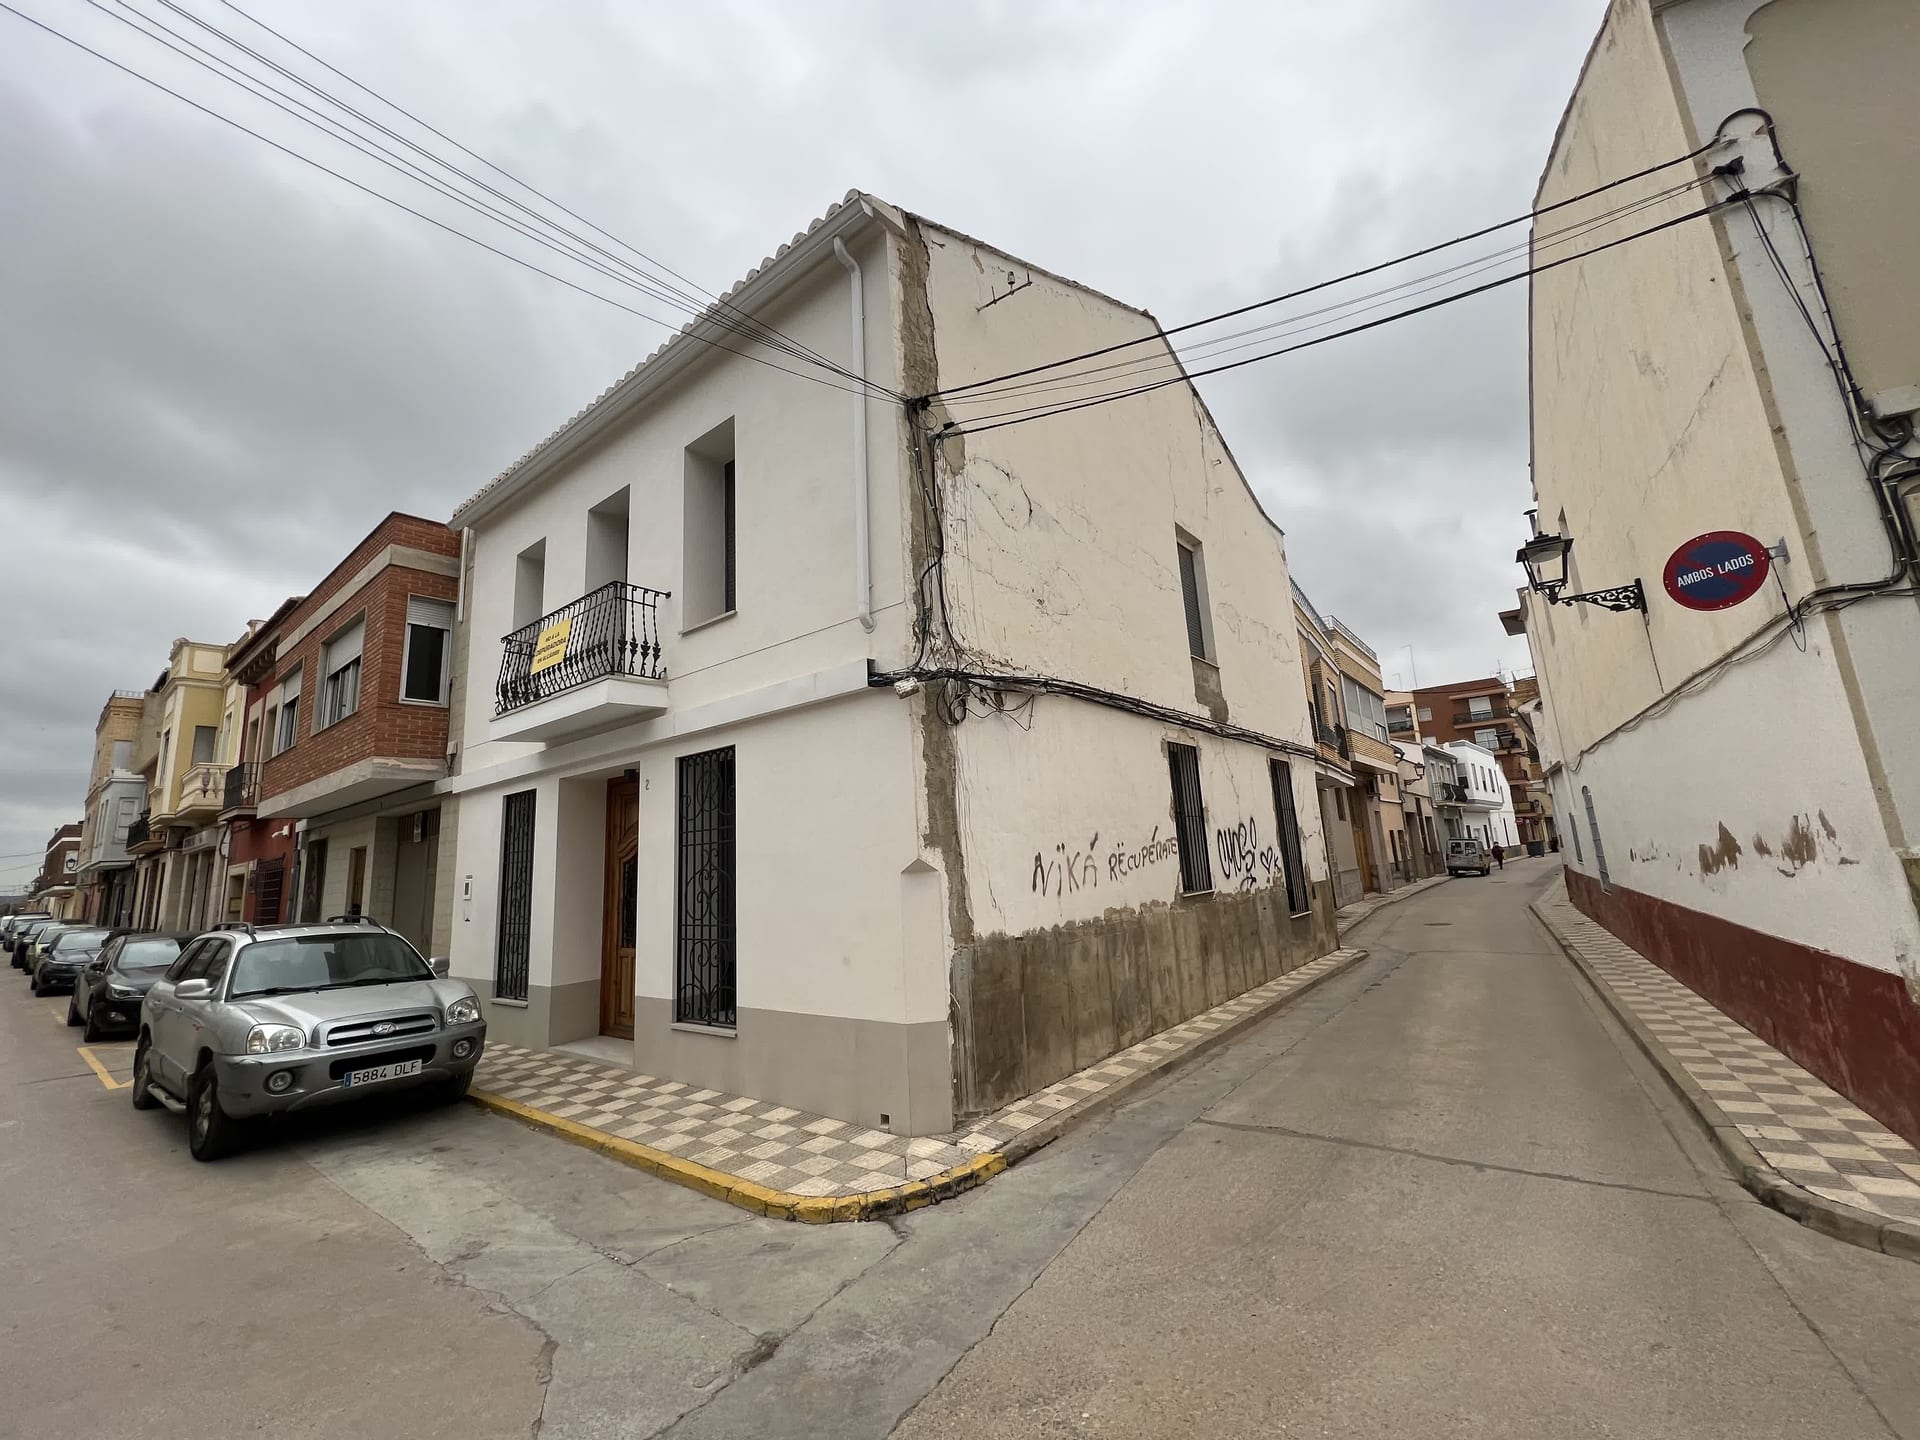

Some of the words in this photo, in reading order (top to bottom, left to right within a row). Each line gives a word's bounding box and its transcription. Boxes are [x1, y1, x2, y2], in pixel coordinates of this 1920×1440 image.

[1677, 566, 1714, 588] AMBOS
[1717, 553, 1754, 575] LADOS
[353, 1067, 387, 1085] 5884
[394, 1060, 419, 1076] DLF
